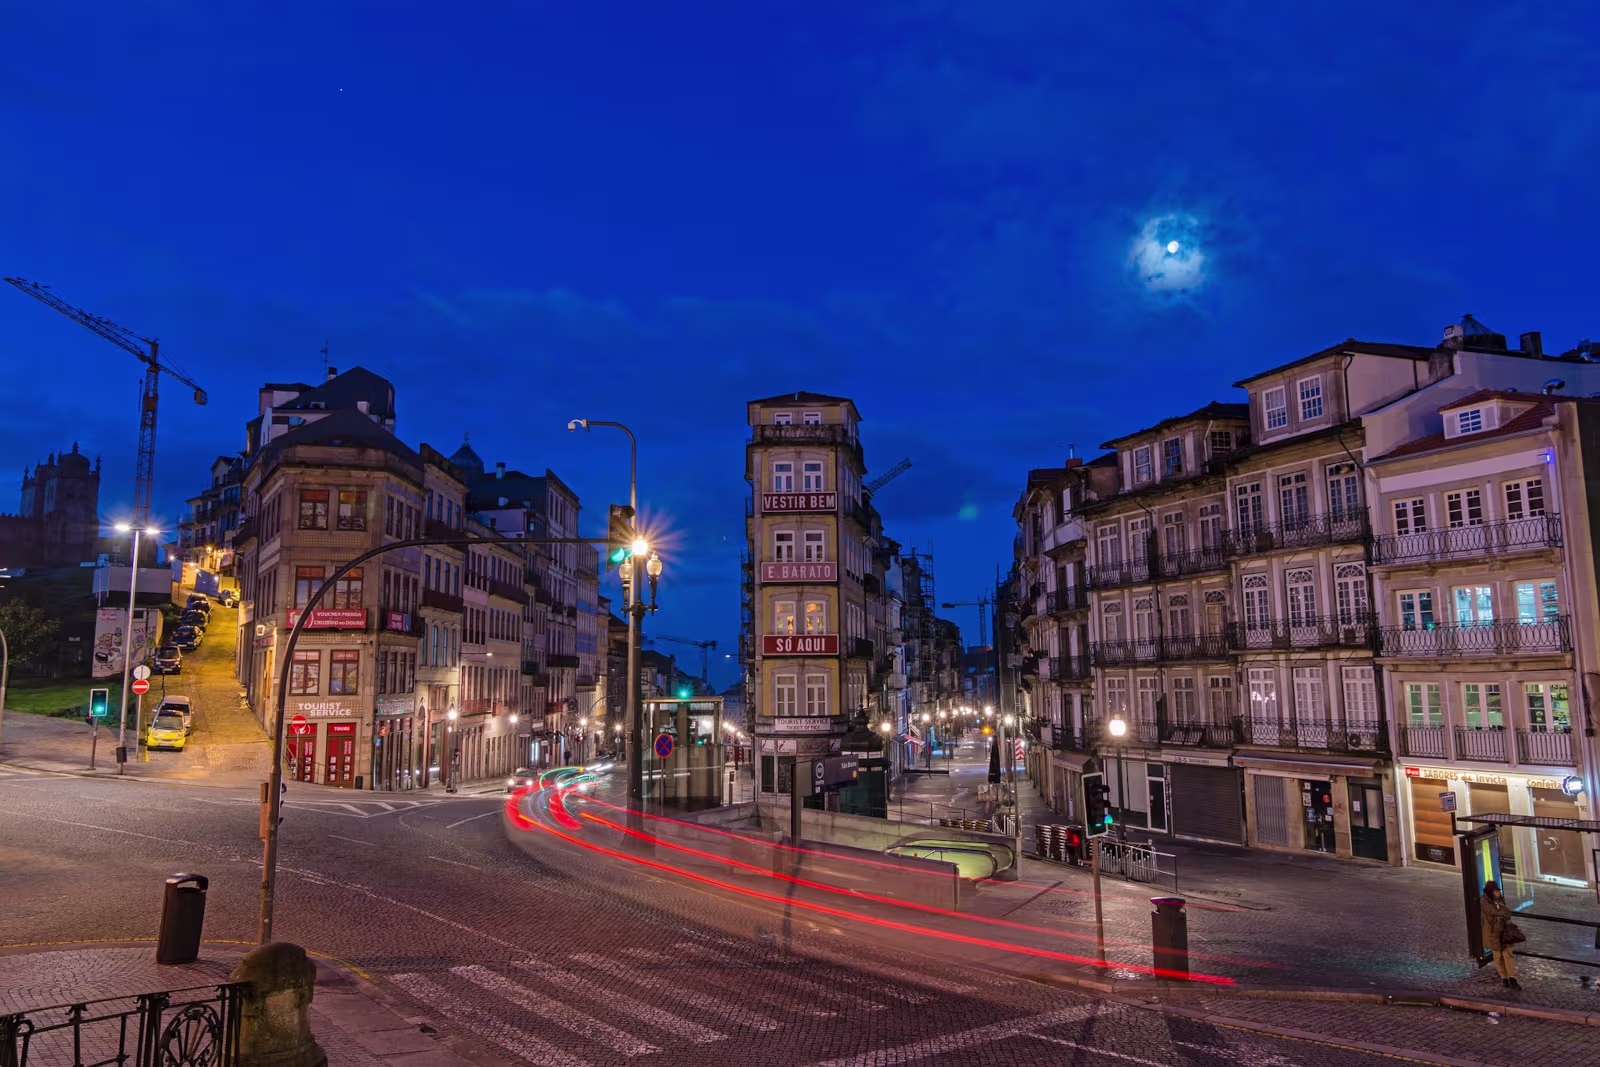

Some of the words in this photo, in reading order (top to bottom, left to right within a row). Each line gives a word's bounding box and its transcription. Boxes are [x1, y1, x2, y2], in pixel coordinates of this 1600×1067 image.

[764, 495, 806, 509] VESTIR
[810, 495, 835, 508] BEM
[782, 565, 831, 579] BARATO
[776, 636, 793, 652] SÓ
[796, 637, 826, 652] AQUI
[298, 702, 341, 711] TOURIST
[1423, 769, 1458, 781] SABORES
